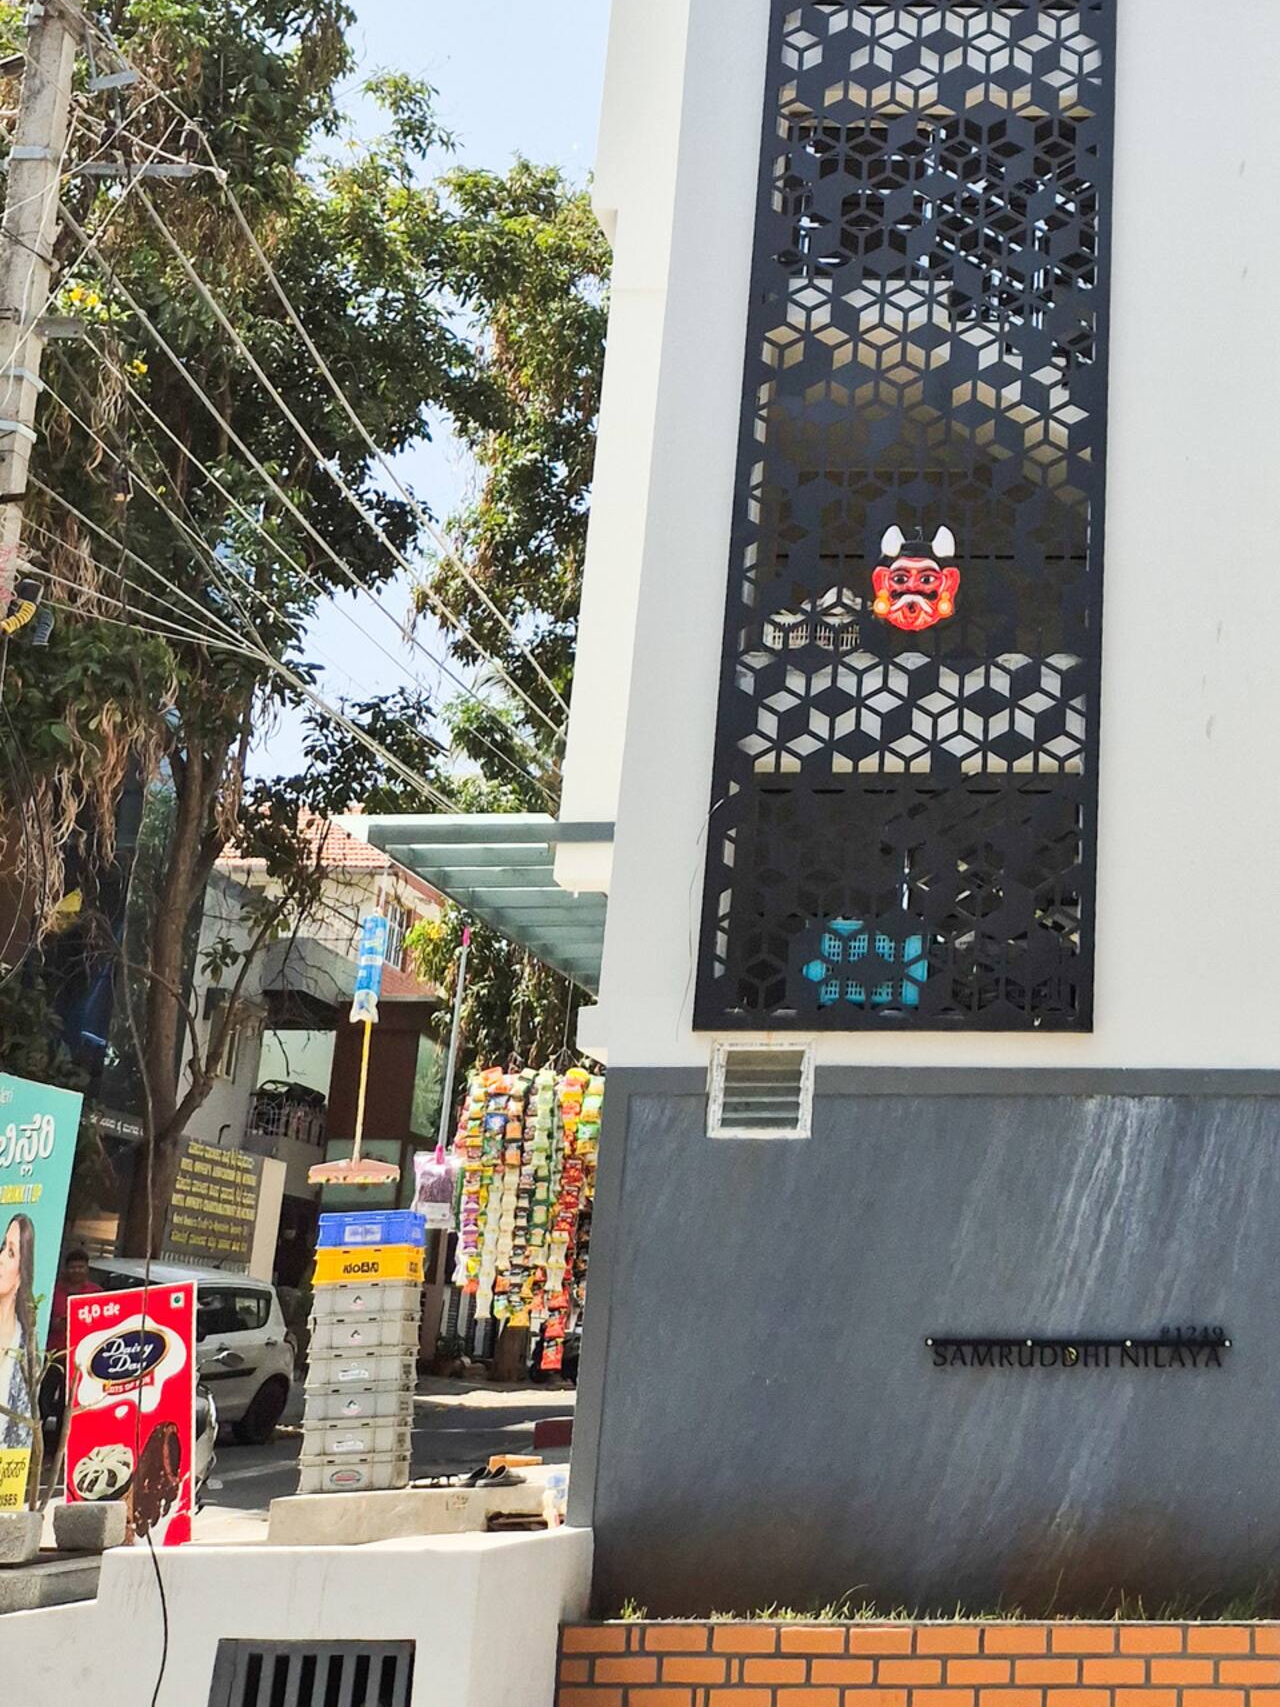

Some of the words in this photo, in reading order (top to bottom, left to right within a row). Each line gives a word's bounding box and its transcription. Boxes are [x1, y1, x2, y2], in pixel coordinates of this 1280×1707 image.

[102, 1337, 154, 1359] Dairy
[933, 1344, 1110, 1367] SAMRUDDHI
[1120, 1345, 1222, 1368] NILAYA
